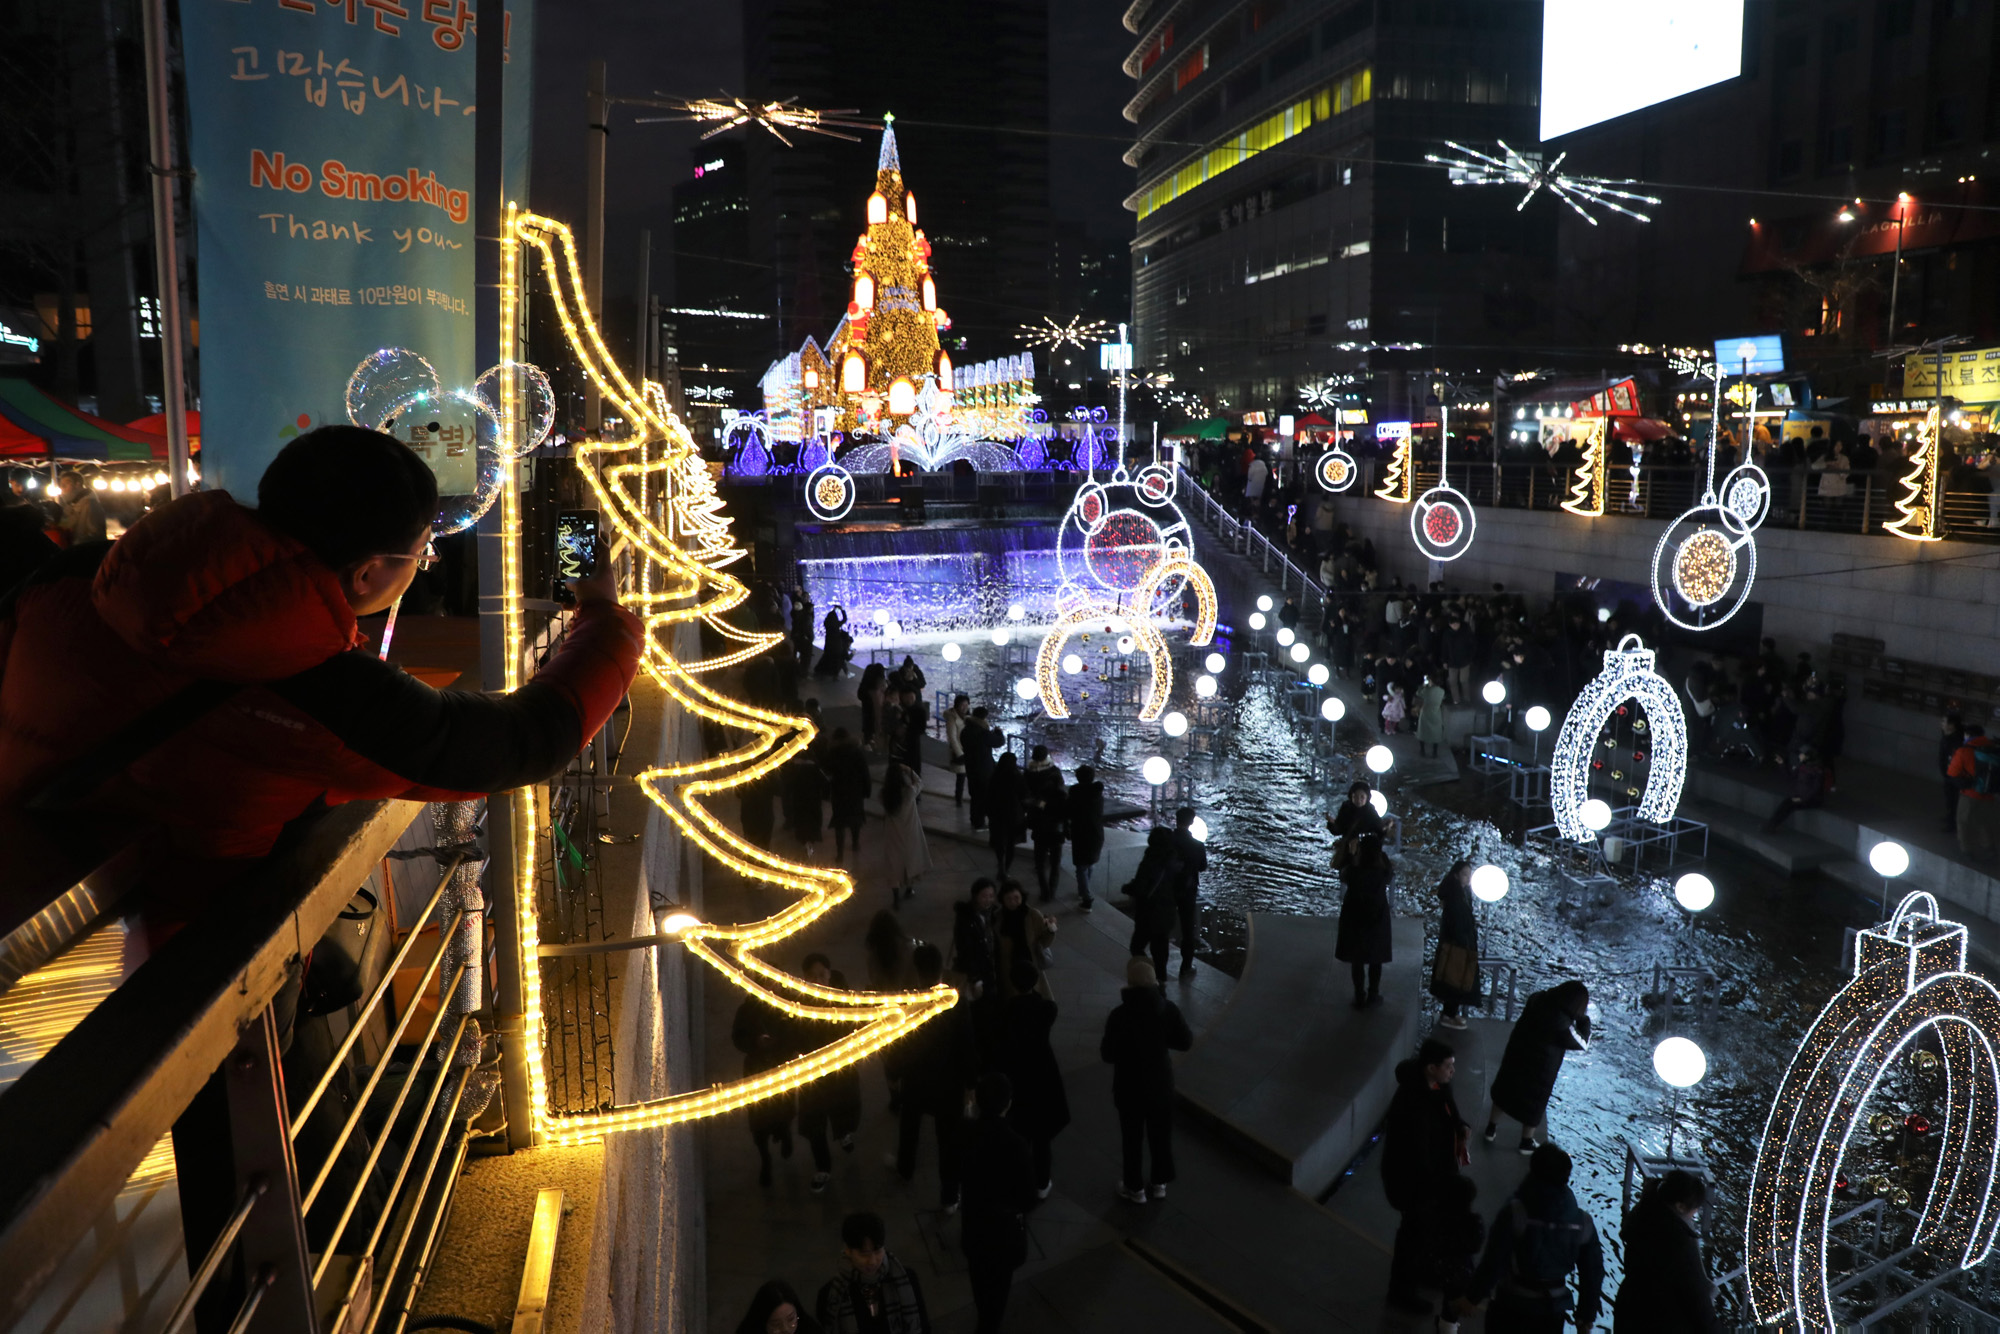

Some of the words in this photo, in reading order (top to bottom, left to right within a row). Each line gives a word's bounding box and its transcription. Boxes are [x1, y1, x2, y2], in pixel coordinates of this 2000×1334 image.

[251, 149, 313, 193] No
[320, 159, 470, 224] Smoking
[258, 213, 374, 244] Thank
[293, 285, 307, 303] 시
[310, 286, 352, 306] 과태료
[358, 284, 422, 305] 10만원이
[1982, 365, 2000, 385] 초
